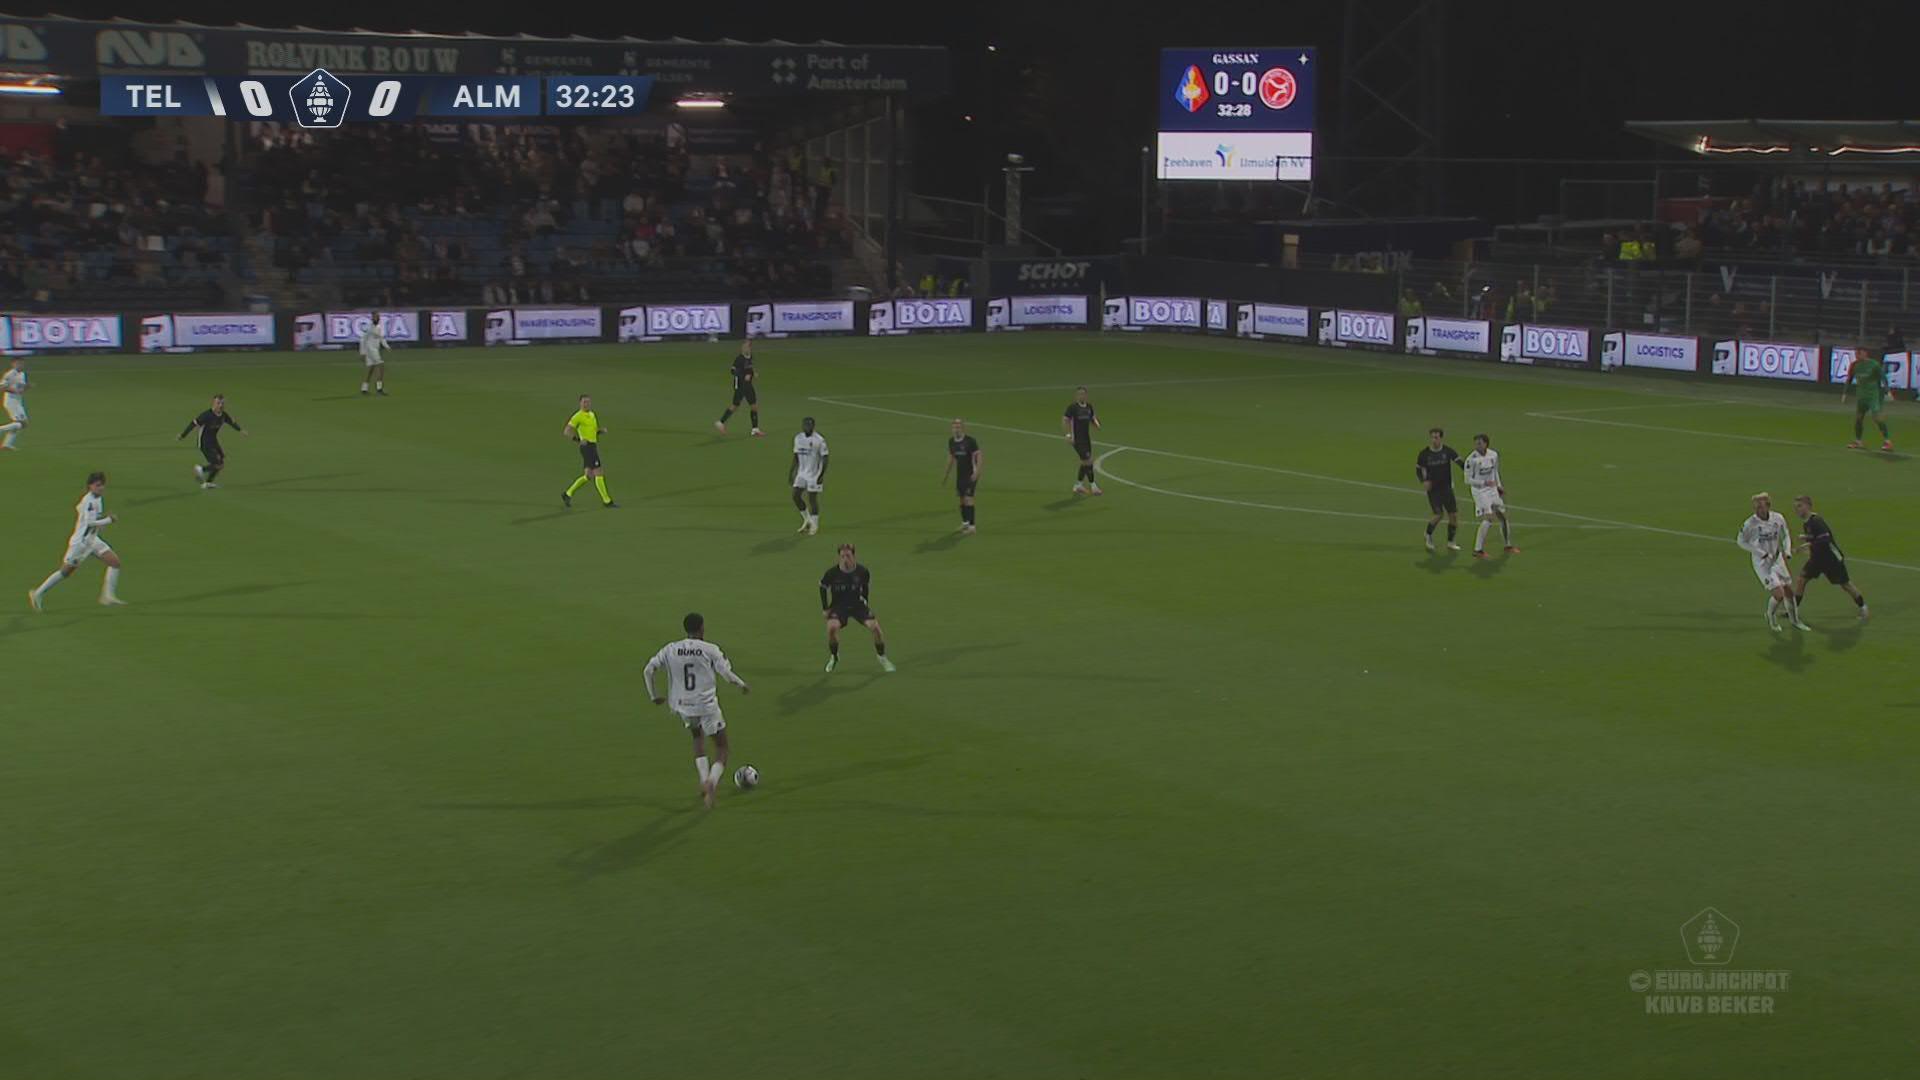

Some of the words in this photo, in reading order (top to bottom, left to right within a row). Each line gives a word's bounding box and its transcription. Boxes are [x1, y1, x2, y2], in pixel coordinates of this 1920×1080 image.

[247, 41, 366, 70] ROLVINK
[371, 46, 460, 73] BOUW
[850, 53, 870, 71] of
[1212, 54, 1259, 64] GASSAN
[807, 74, 908, 90] Amsterdam
[1217, 104, 1252, 117] 32:28
[1018, 262, 1091, 281] SCHOT
[651, 307, 722, 332] BOTA
[782, 310, 843, 322] TRANSPORT
[900, 303, 964, 325] BOTA
[1024, 304, 1073, 316] LOGISTICS
[1133, 301, 1196, 324] BOTA
[20, 318, 111, 345] BOTA
[191, 323, 258, 336] LOGISTICS
[1340, 313, 1389, 341] BOTA
[1431, 326, 1481, 342] TRANSPORT
[1525, 328, 1584, 358] BOTA
[1635, 339, 1685, 359] LOGISTICS
[1742, 345, 1812, 377] BOTA
[677, 647, 703, 657] BUKO
[684, 663, 696, 691] 6
